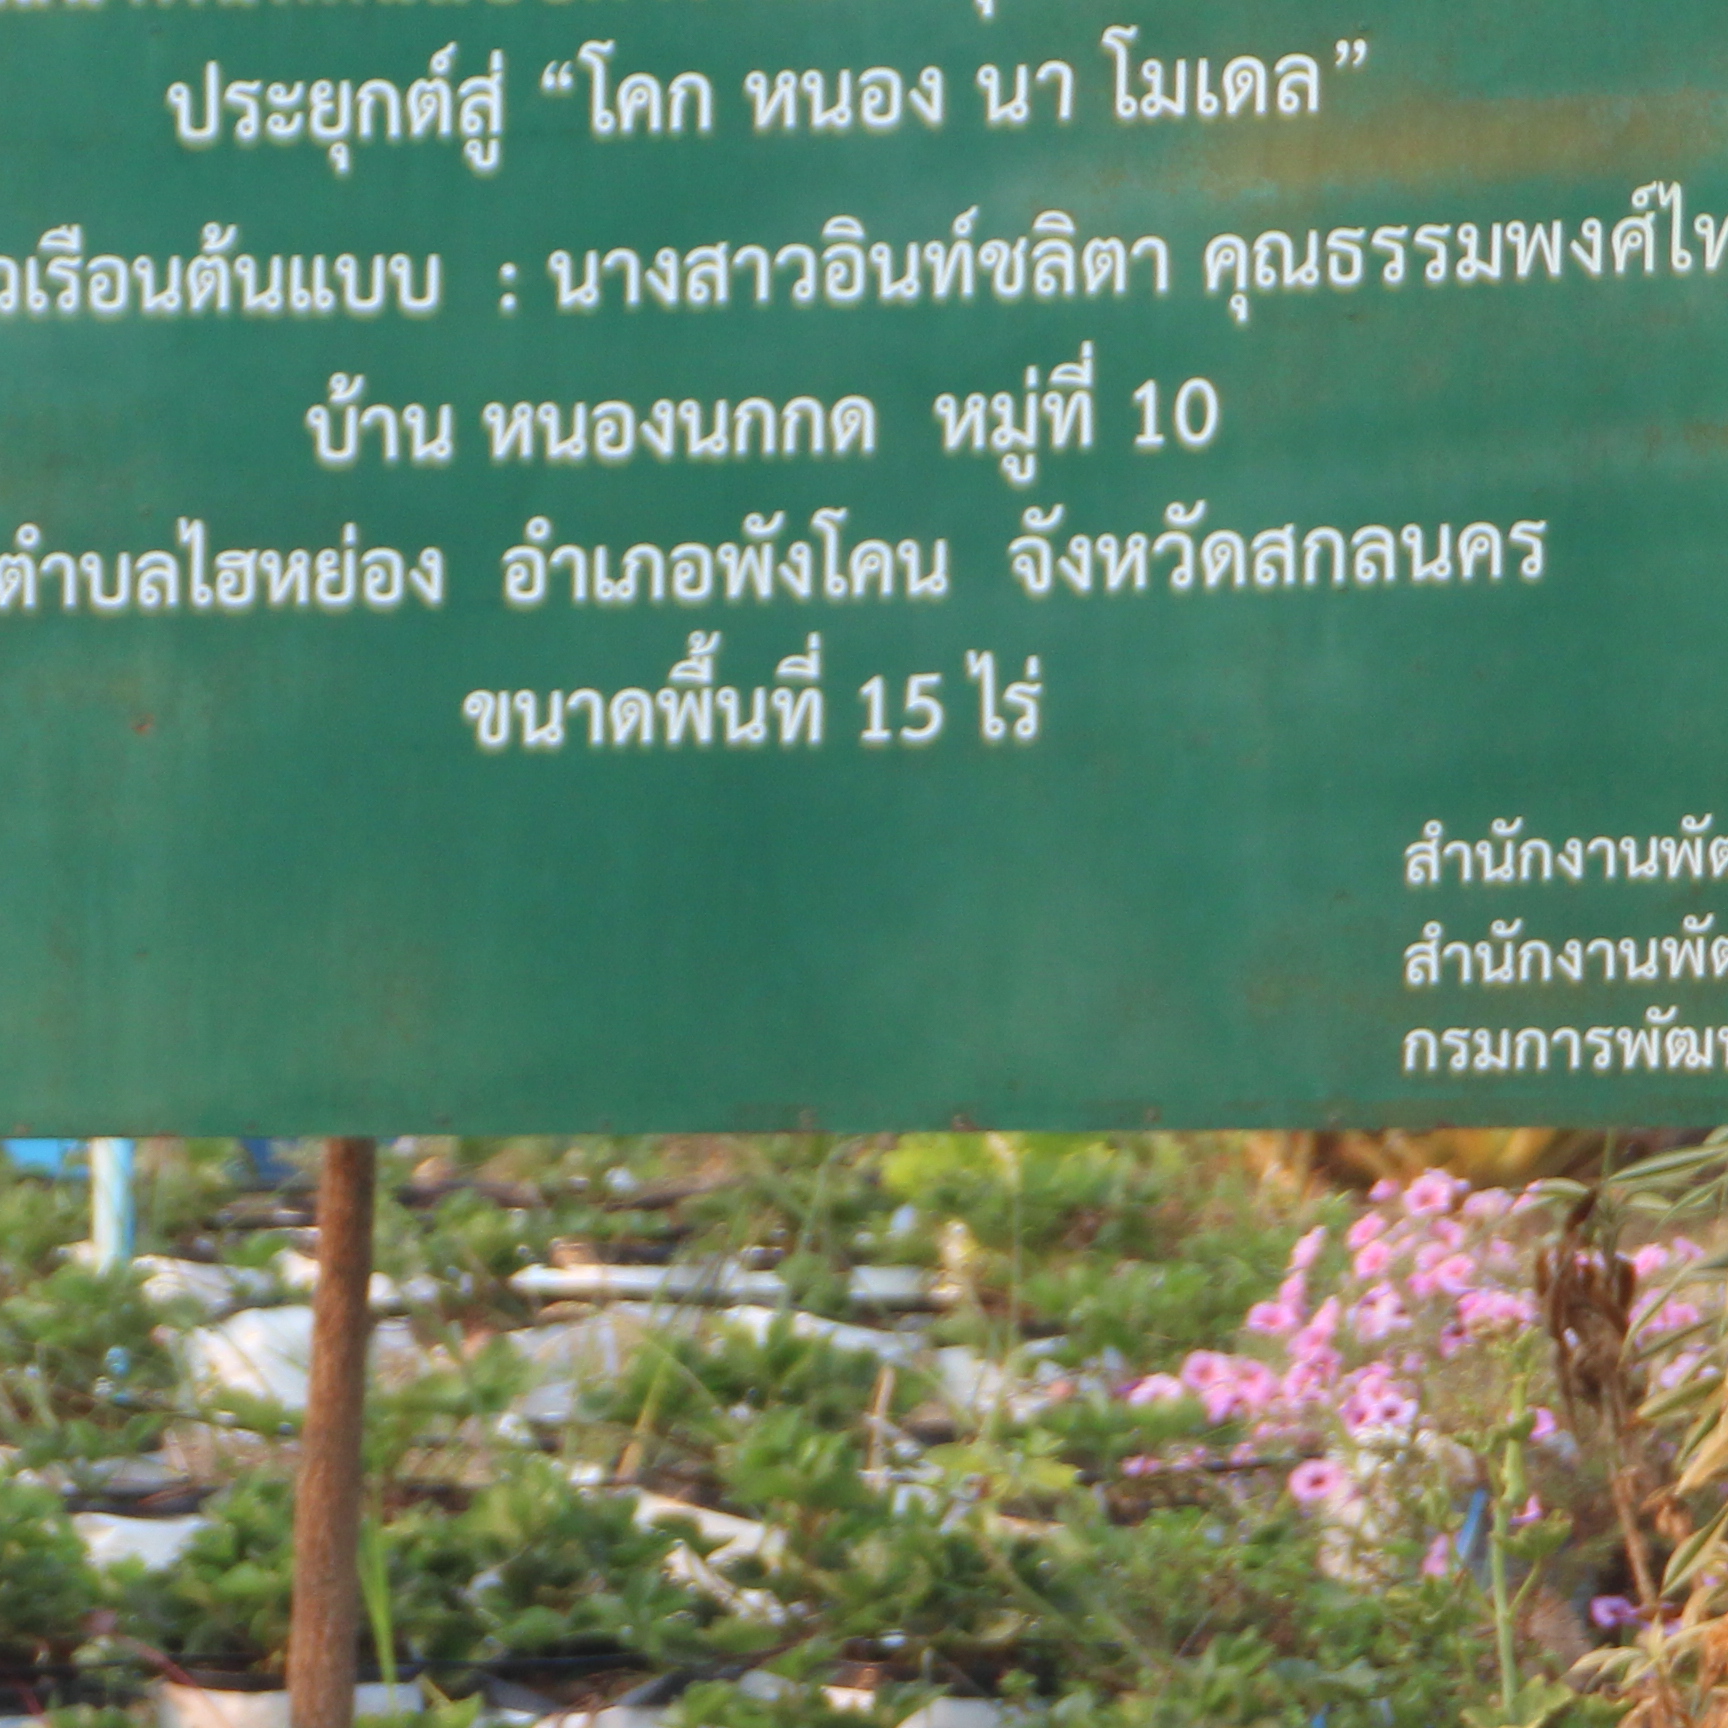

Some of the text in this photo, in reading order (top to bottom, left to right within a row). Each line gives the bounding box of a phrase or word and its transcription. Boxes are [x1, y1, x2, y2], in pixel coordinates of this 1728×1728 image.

[167, 25, 1367, 171] ประยุกต์สู่ “โคก หนอง นา โมเดล”
[500, 262, 516, 309] :
[548, 205, 1169, 307] นางสาวอินท์ชลิตา
[306, 340, 1219, 484] บ้าน หนองนกกด หมู่ที่ 10
[502, 507, 948, 603] อำเภอพังโคน
[1008, 499, 1546, 594] จังหวัดสกลนคร
[463, 630, 1042, 747] ขนาดพื้นที่ 15 ไร่
[1404, 1005, 1728, 1071] กรมการพัฒ
